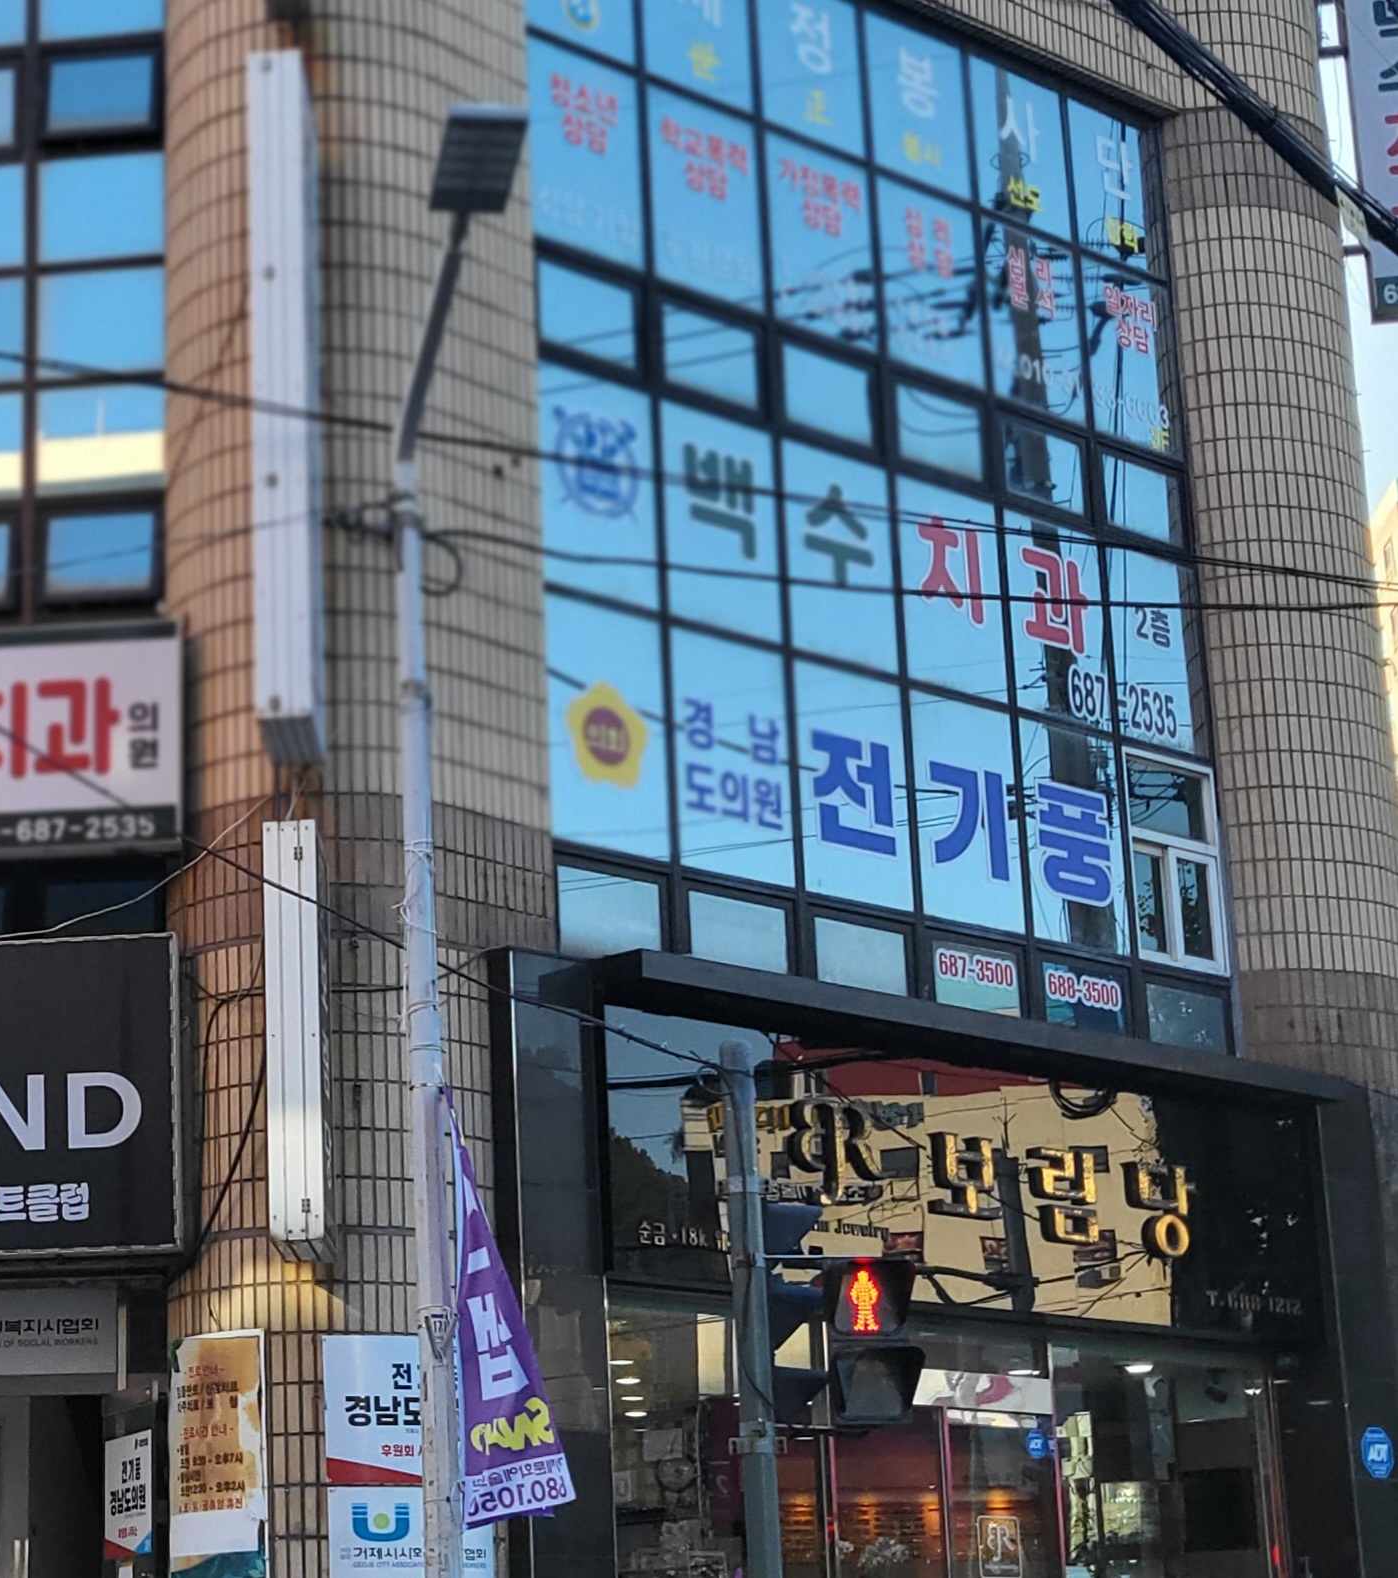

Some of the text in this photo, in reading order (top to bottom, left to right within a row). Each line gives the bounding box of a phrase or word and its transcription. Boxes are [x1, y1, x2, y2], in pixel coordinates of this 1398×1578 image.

[1104, 285, 1158, 333] 일자리
[1116, 318, 1150, 356] 상담
[1135, 606, 1171, 649] 2층
[1070, 667, 1178, 740] 687-2535
[684, 697, 780, 767] 경남
[685, 762, 784, 831] 도의원
[809, 727, 1114, 907] 전기풍
[937, 951, 1015, 988] 687-3500
[1047, 973, 1120, 1009] 688-3500
[638, 1220, 666, 1246] 순금
[834, 1218, 890, 1243] Jewelry
[345, 1396, 422, 1427] 경남도
[380, 1444, 415, 1458] 후원회
[1368, 1443, 1389, 1463] ADT
[121, 1457, 141, 1484] 전기풍
[109, 1483, 147, 1517] 경남도의원
